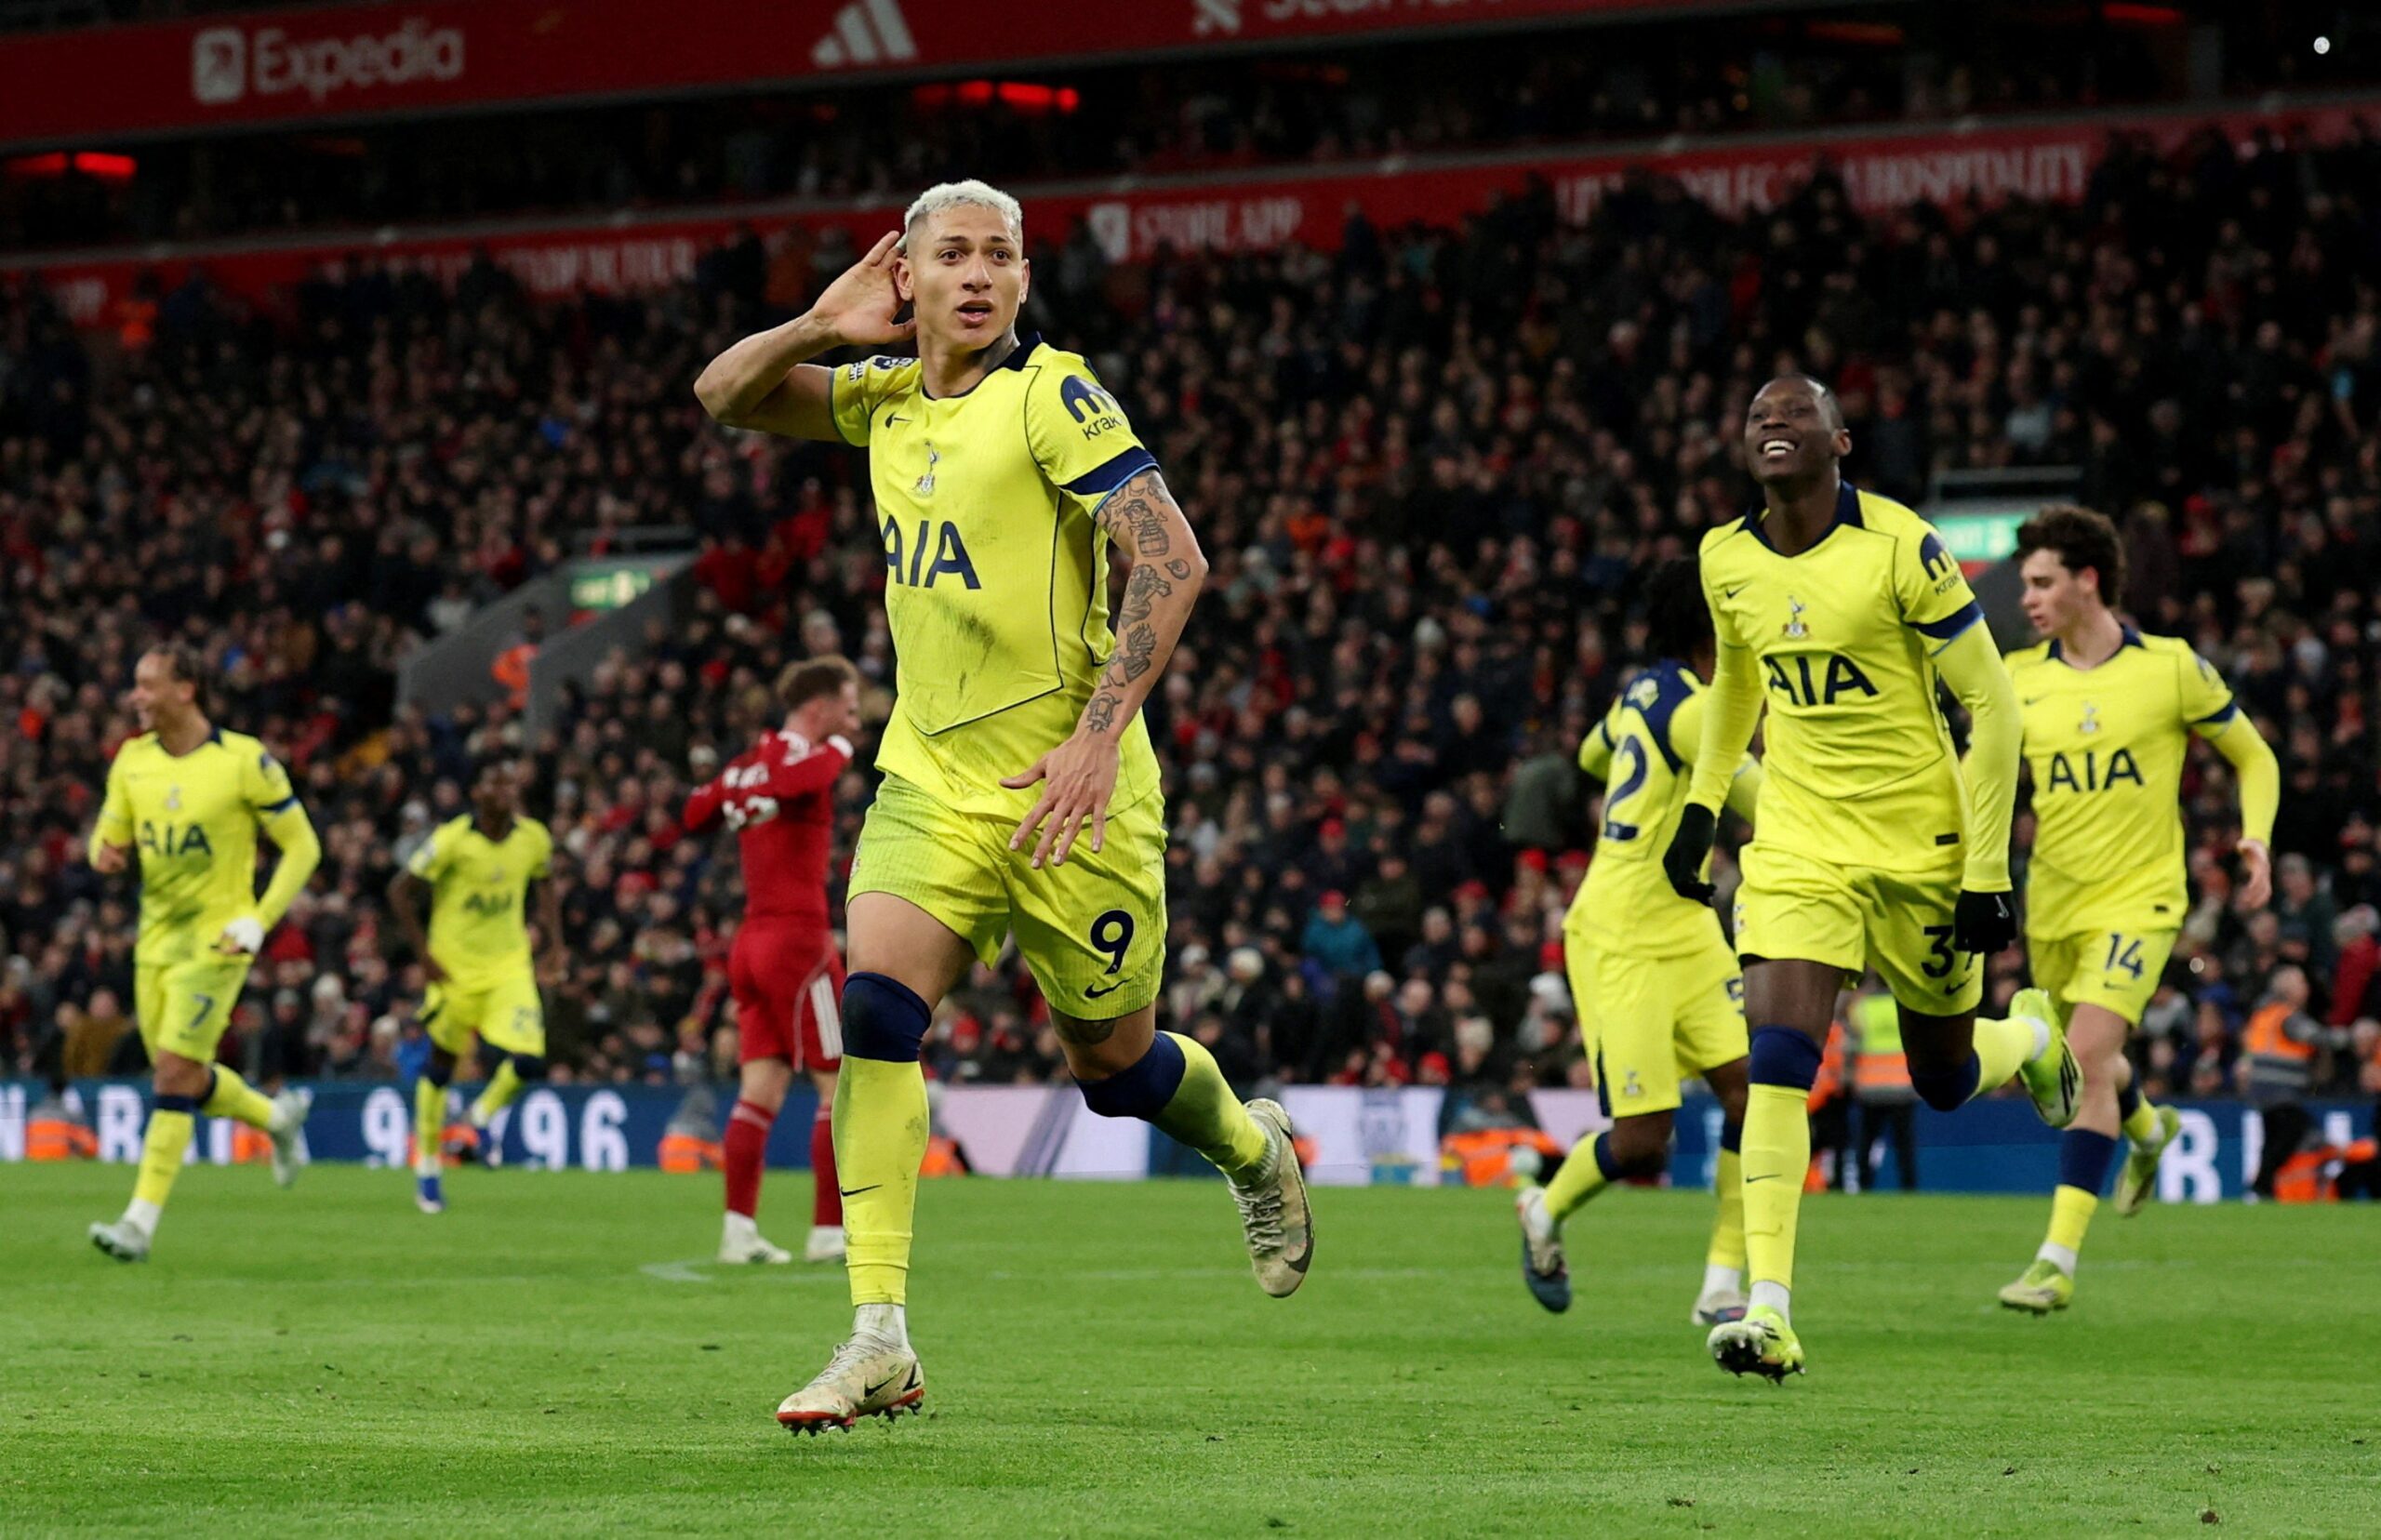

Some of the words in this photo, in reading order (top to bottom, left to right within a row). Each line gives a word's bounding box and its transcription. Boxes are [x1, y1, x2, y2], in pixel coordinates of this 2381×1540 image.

[882, 514, 982, 591] AIA
[1762, 653, 1881, 706] AIA
[2048, 748, 2145, 793] AIA
[138, 819, 213, 856] AIA
[1090, 909, 1135, 975] 9
[1921, 924, 1973, 978] 3
[2105, 933, 2144, 979] 14
[191, 993, 215, 1029] 7
